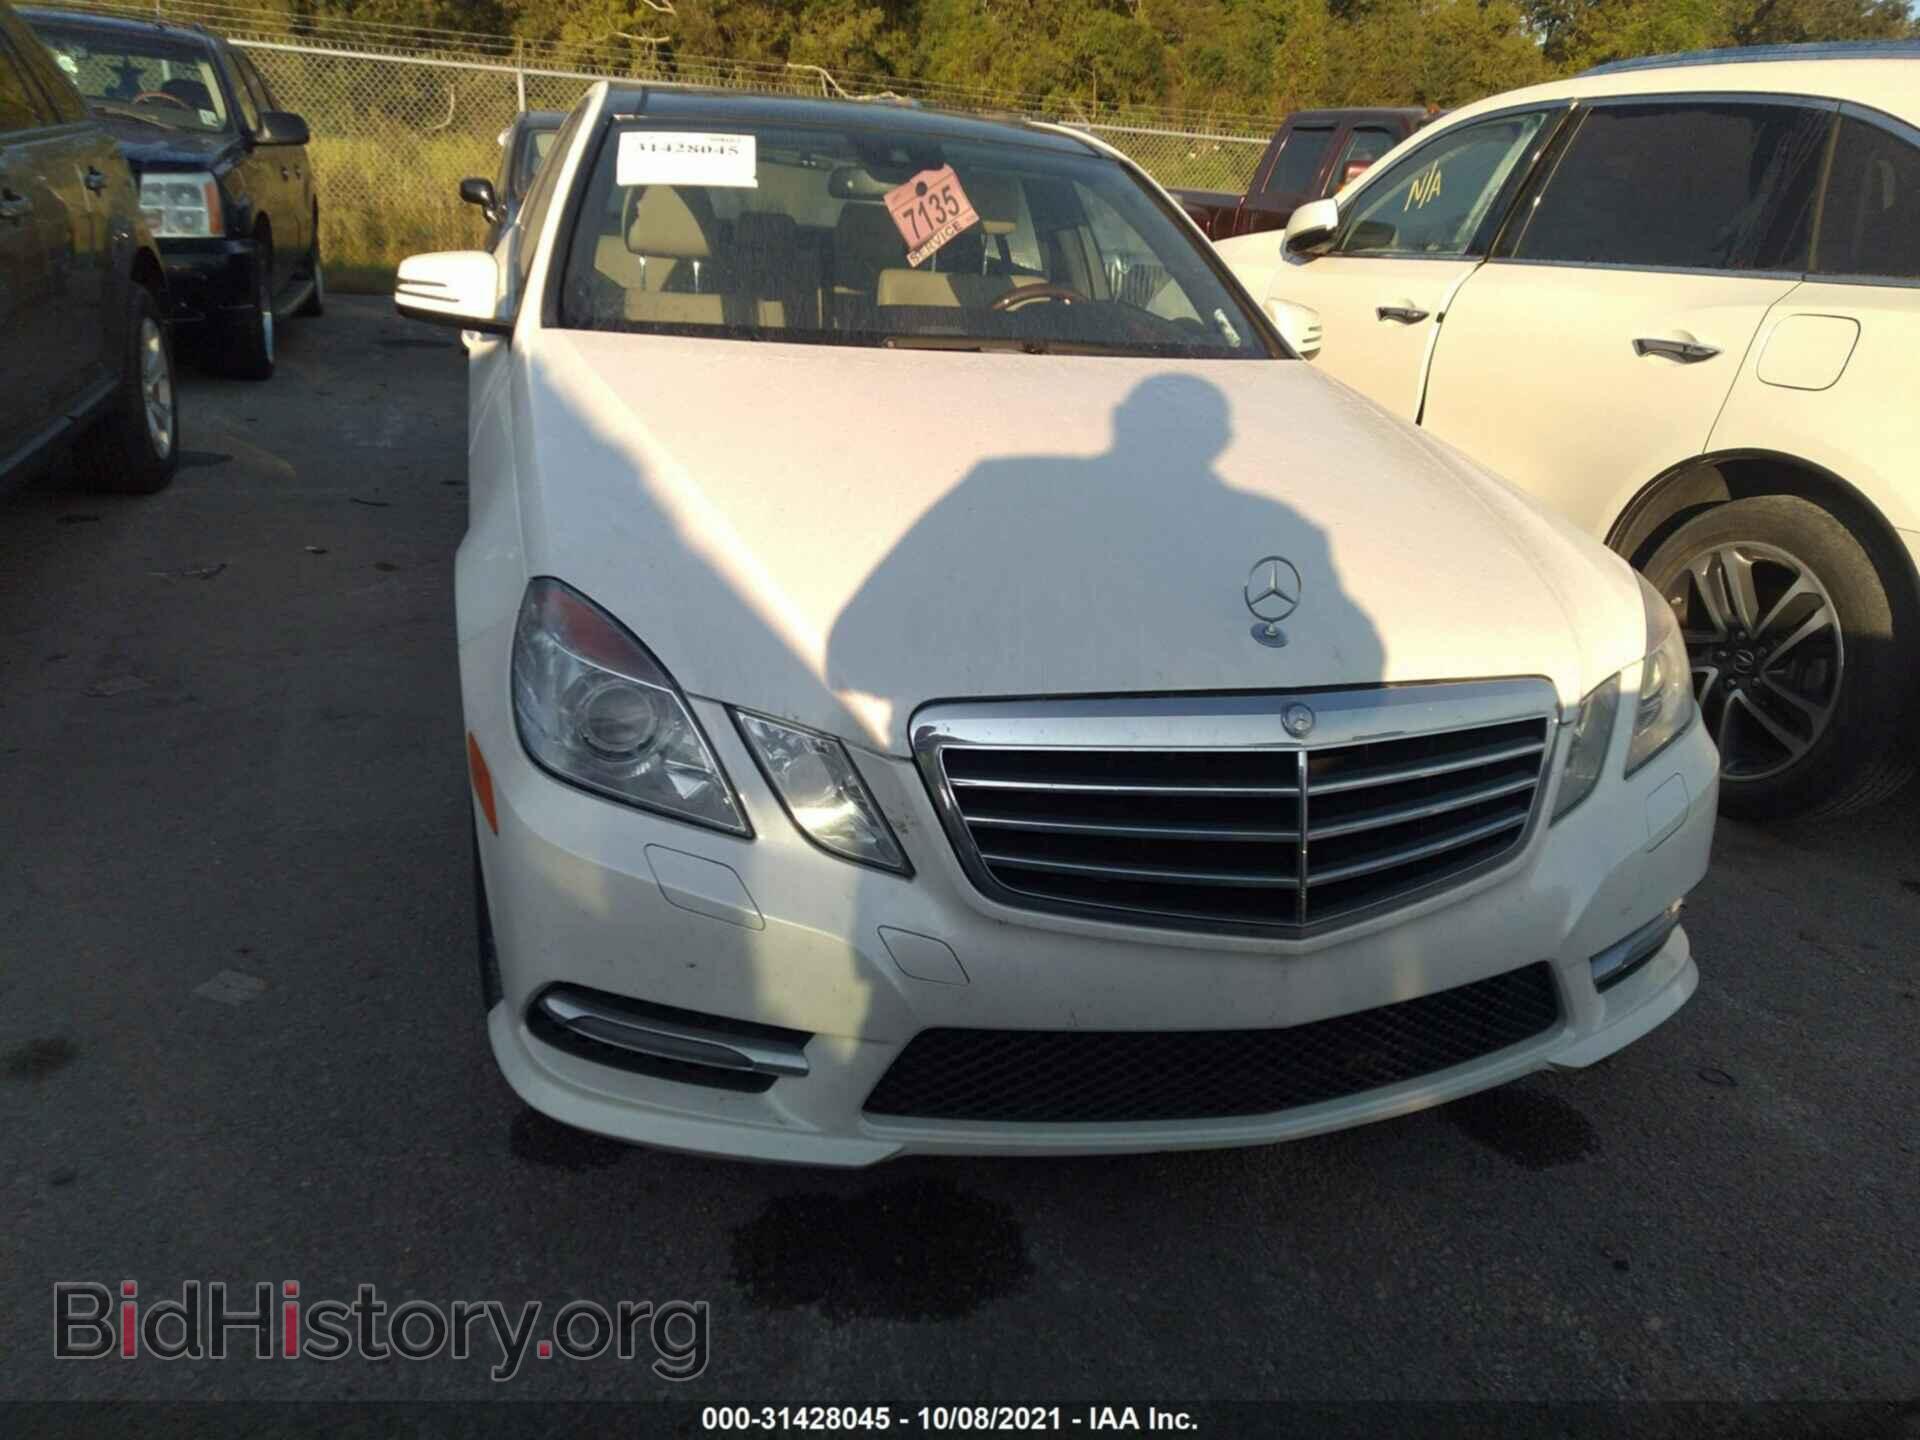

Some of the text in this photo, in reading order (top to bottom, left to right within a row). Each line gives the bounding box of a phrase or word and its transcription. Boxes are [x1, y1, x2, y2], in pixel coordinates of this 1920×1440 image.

[1404, 159, 1441, 211] N/A
[902, 184, 960, 241] 7135
[909, 220, 962, 264] SERVICE
